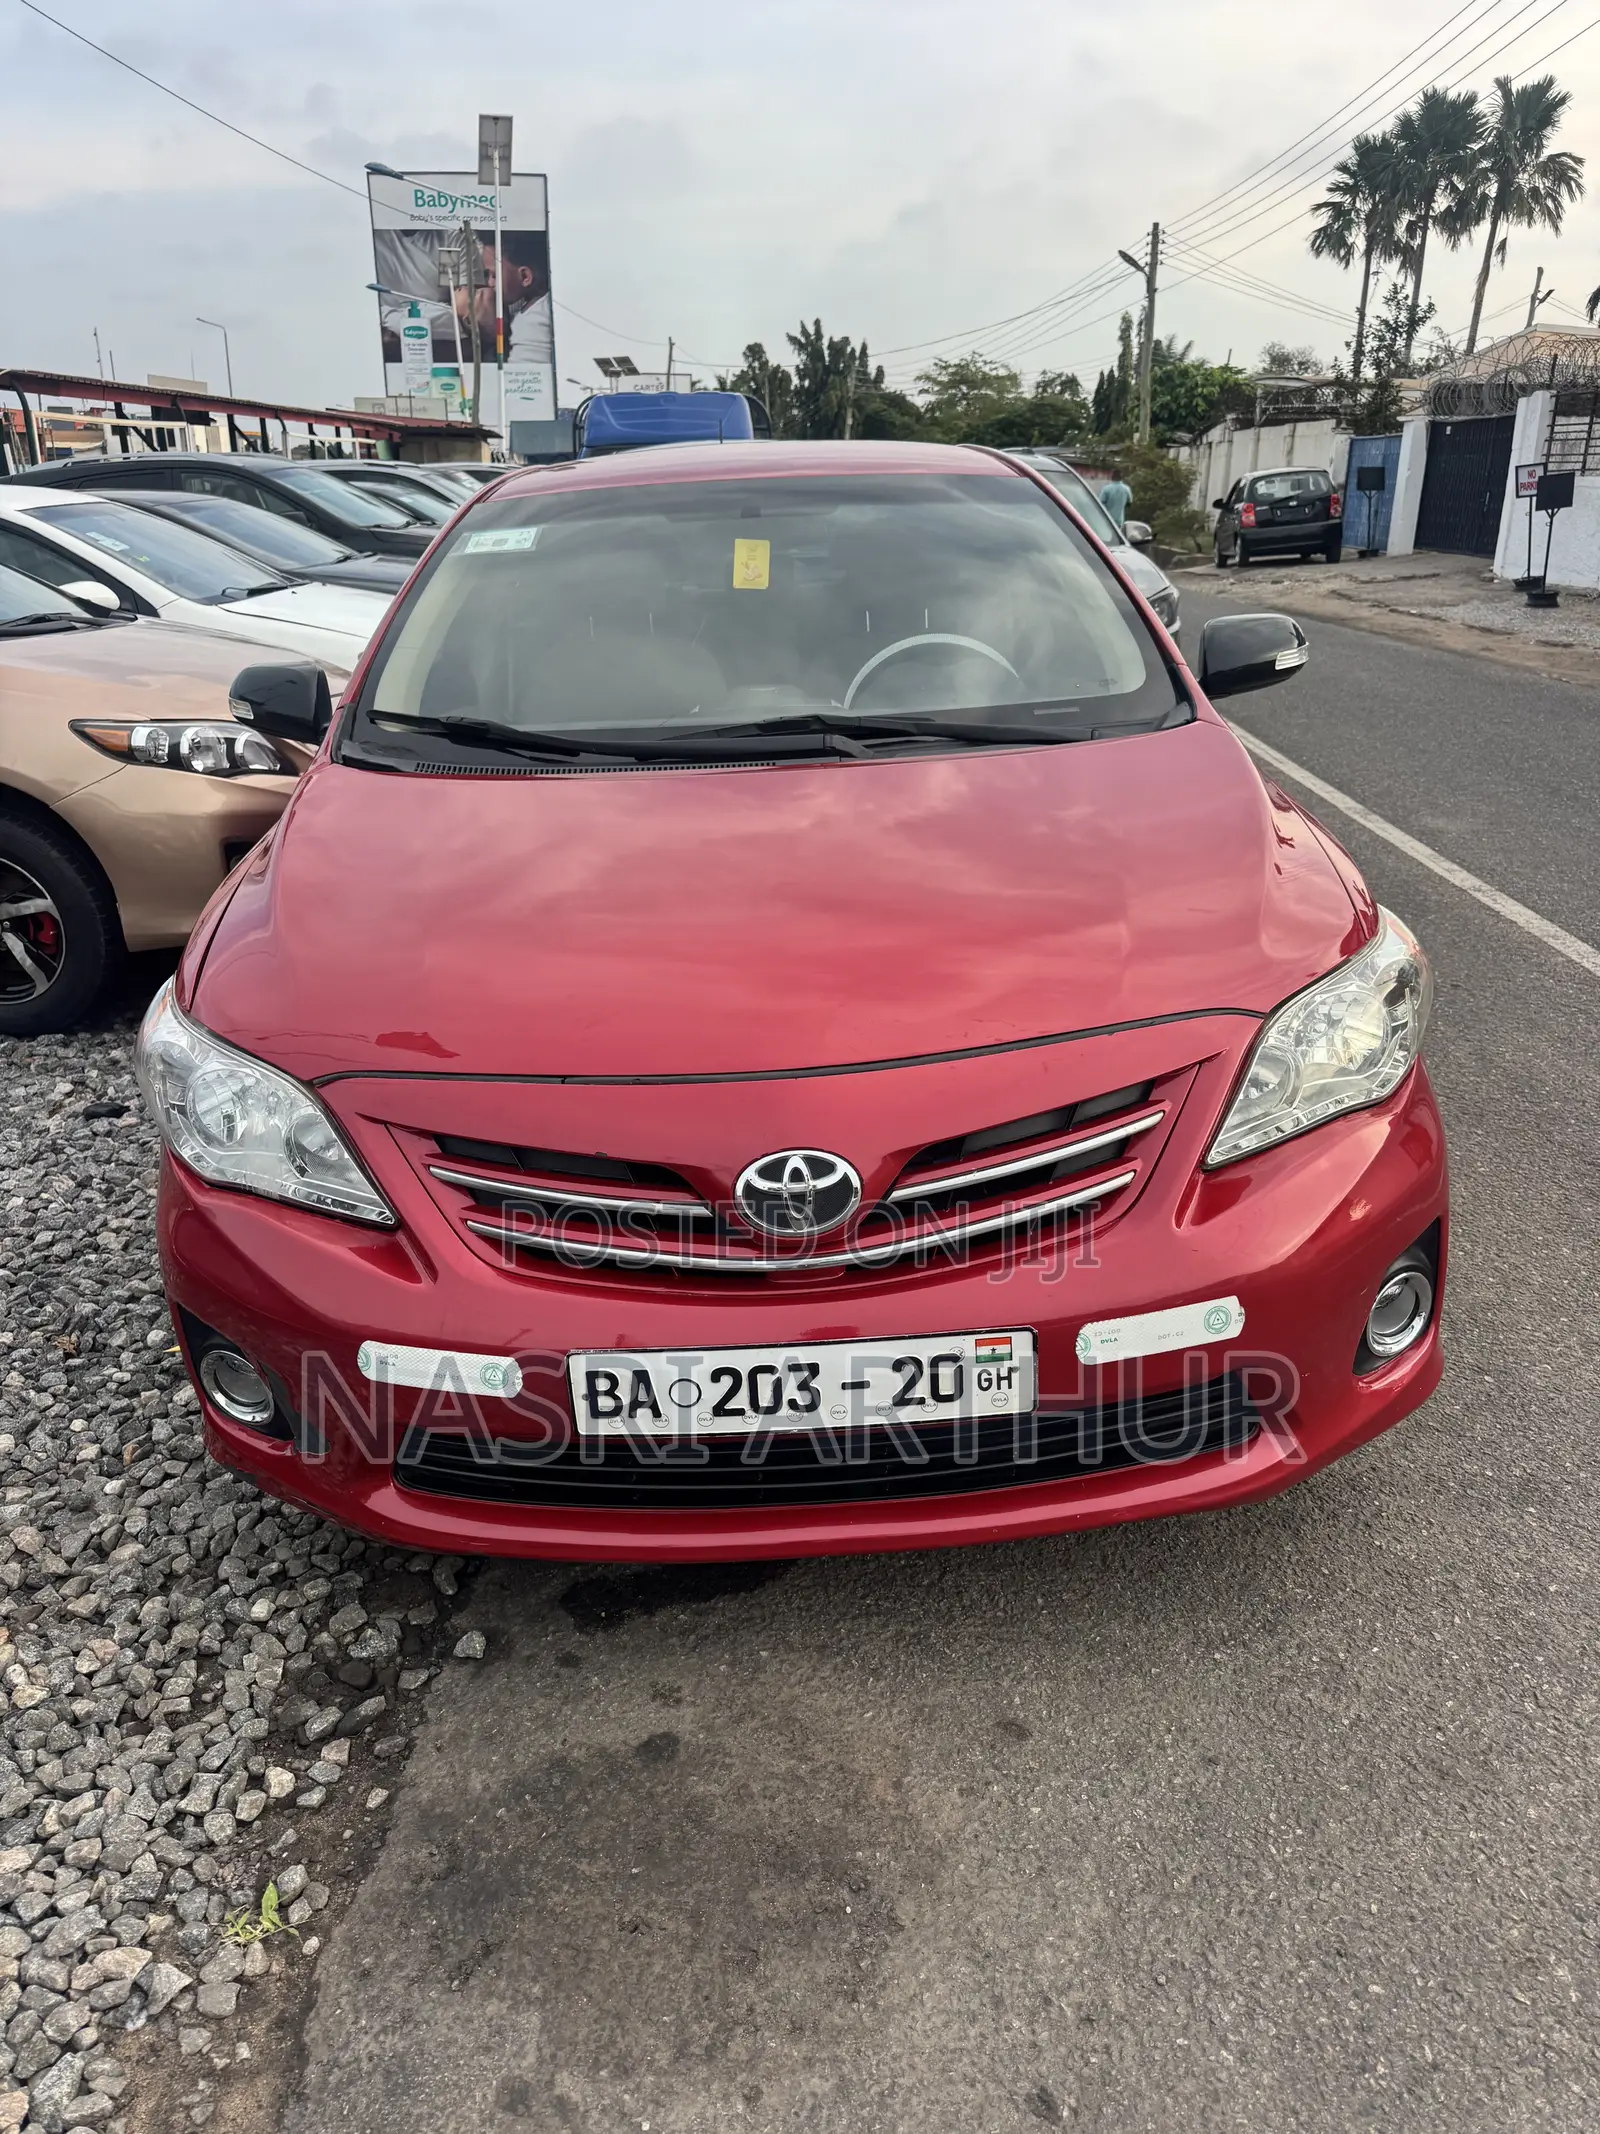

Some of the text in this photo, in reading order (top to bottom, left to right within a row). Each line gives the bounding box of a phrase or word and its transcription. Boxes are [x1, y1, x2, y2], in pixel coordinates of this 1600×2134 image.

[435, 213, 460, 222] specific
[1528, 469, 1536, 479] NO
[1100, 1337, 1118, 1345] DVLA
[977, 1366, 1013, 1391] GH
[585, 1369, 663, 1420] BA
[710, 1362, 821, 1417] 203
[891, 1352, 965, 1408] 20
